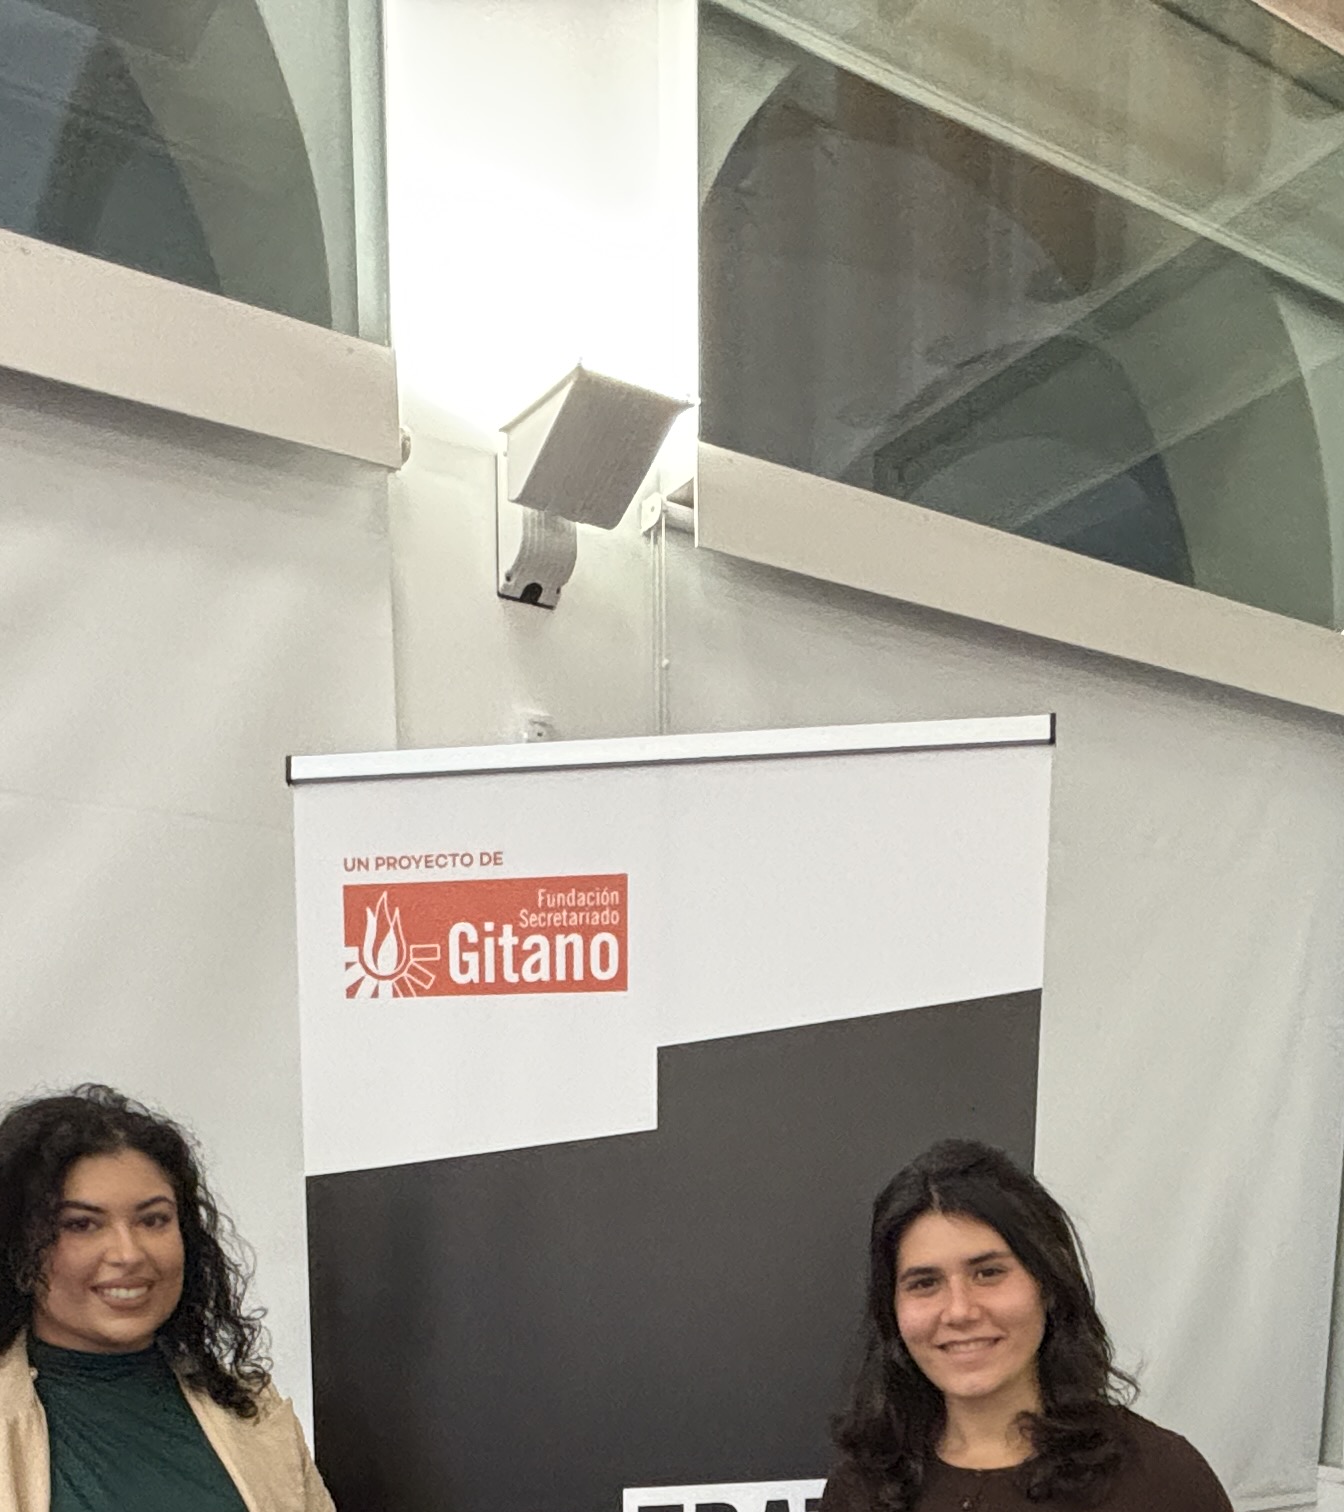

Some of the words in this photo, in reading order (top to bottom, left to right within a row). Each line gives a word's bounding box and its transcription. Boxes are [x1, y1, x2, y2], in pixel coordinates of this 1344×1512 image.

[343, 857, 370, 872] UN
[374, 852, 474, 871] PROYECTO
[479, 851, 504, 867] DE
[537, 887, 620, 908] Fundación
[519, 907, 620, 929] Secretariado
[448, 921, 619, 984] Gitano
